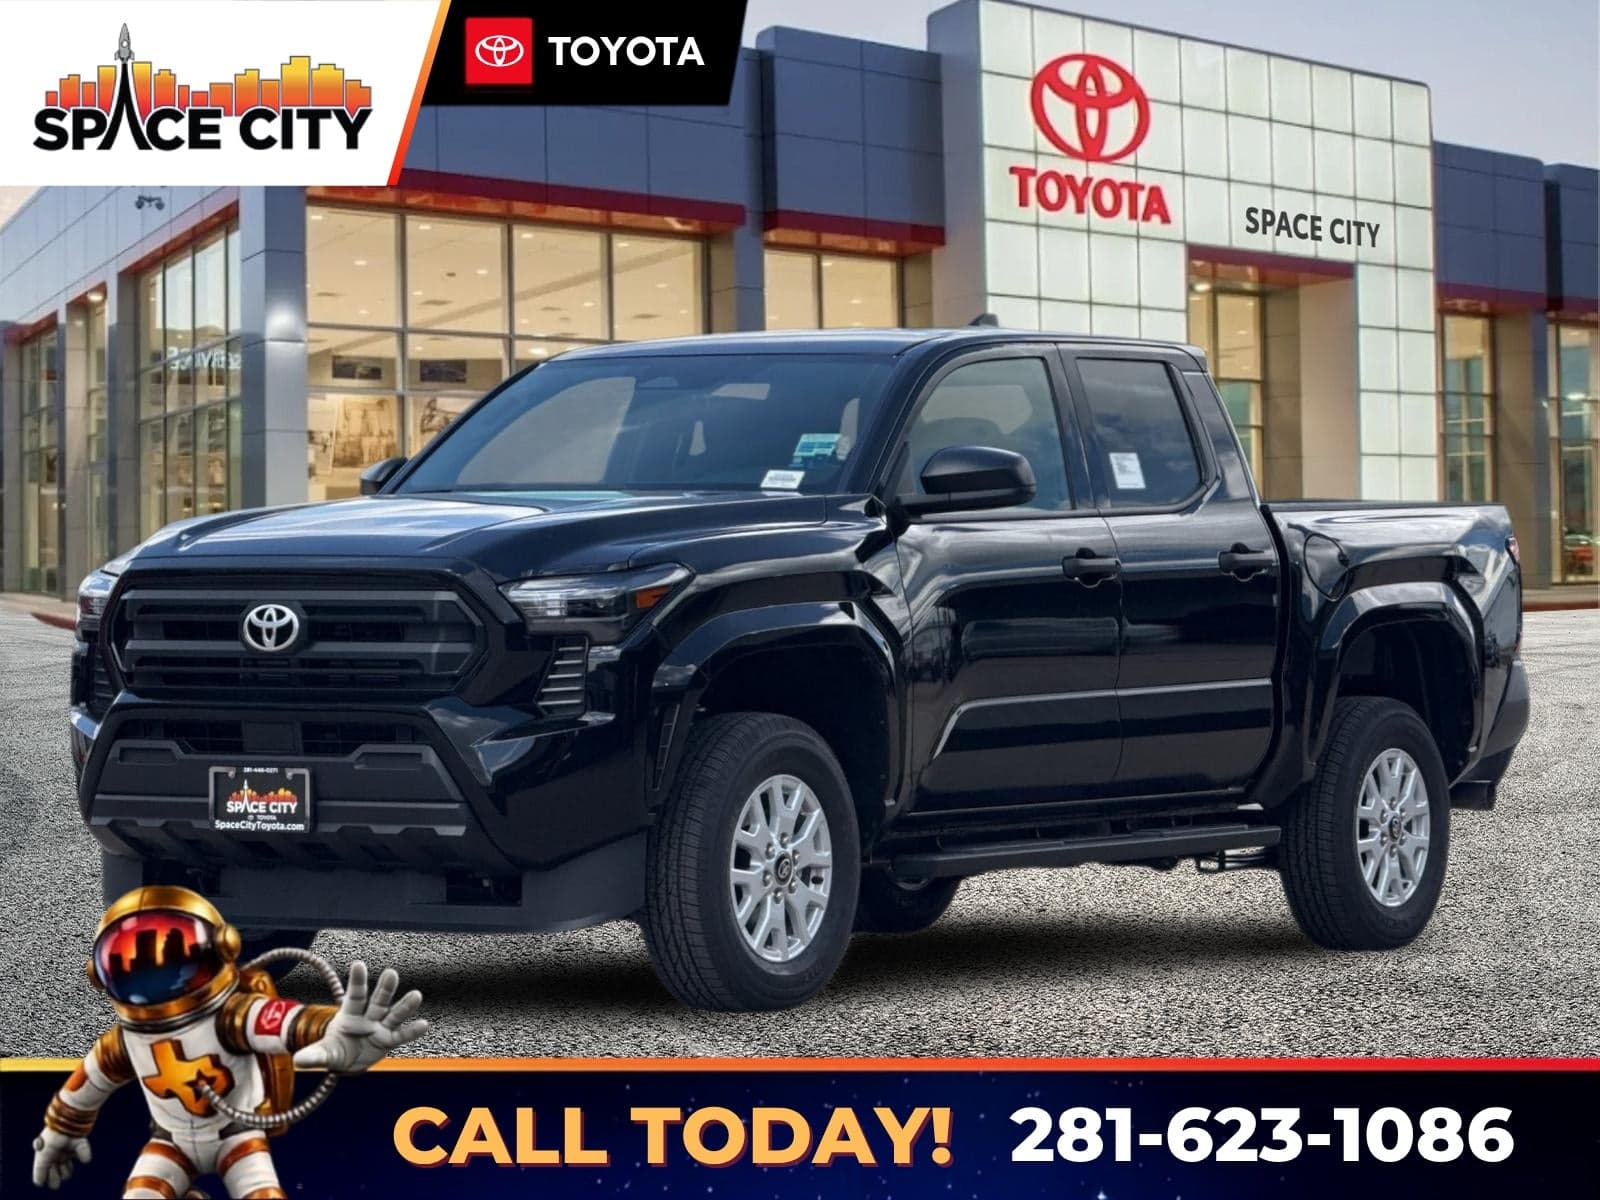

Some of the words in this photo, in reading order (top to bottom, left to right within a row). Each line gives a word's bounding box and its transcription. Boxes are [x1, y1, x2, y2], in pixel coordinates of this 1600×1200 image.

[1009, 166, 1171, 224] TOYOTA
[1245, 206, 1322, 242] SPACE
[1329, 217, 1380, 248] CITY
[226, 800, 267, 813] SPACE
[269, 801, 298, 814] CITY
[214, 819, 305, 831] SpaceCityToyota.com
